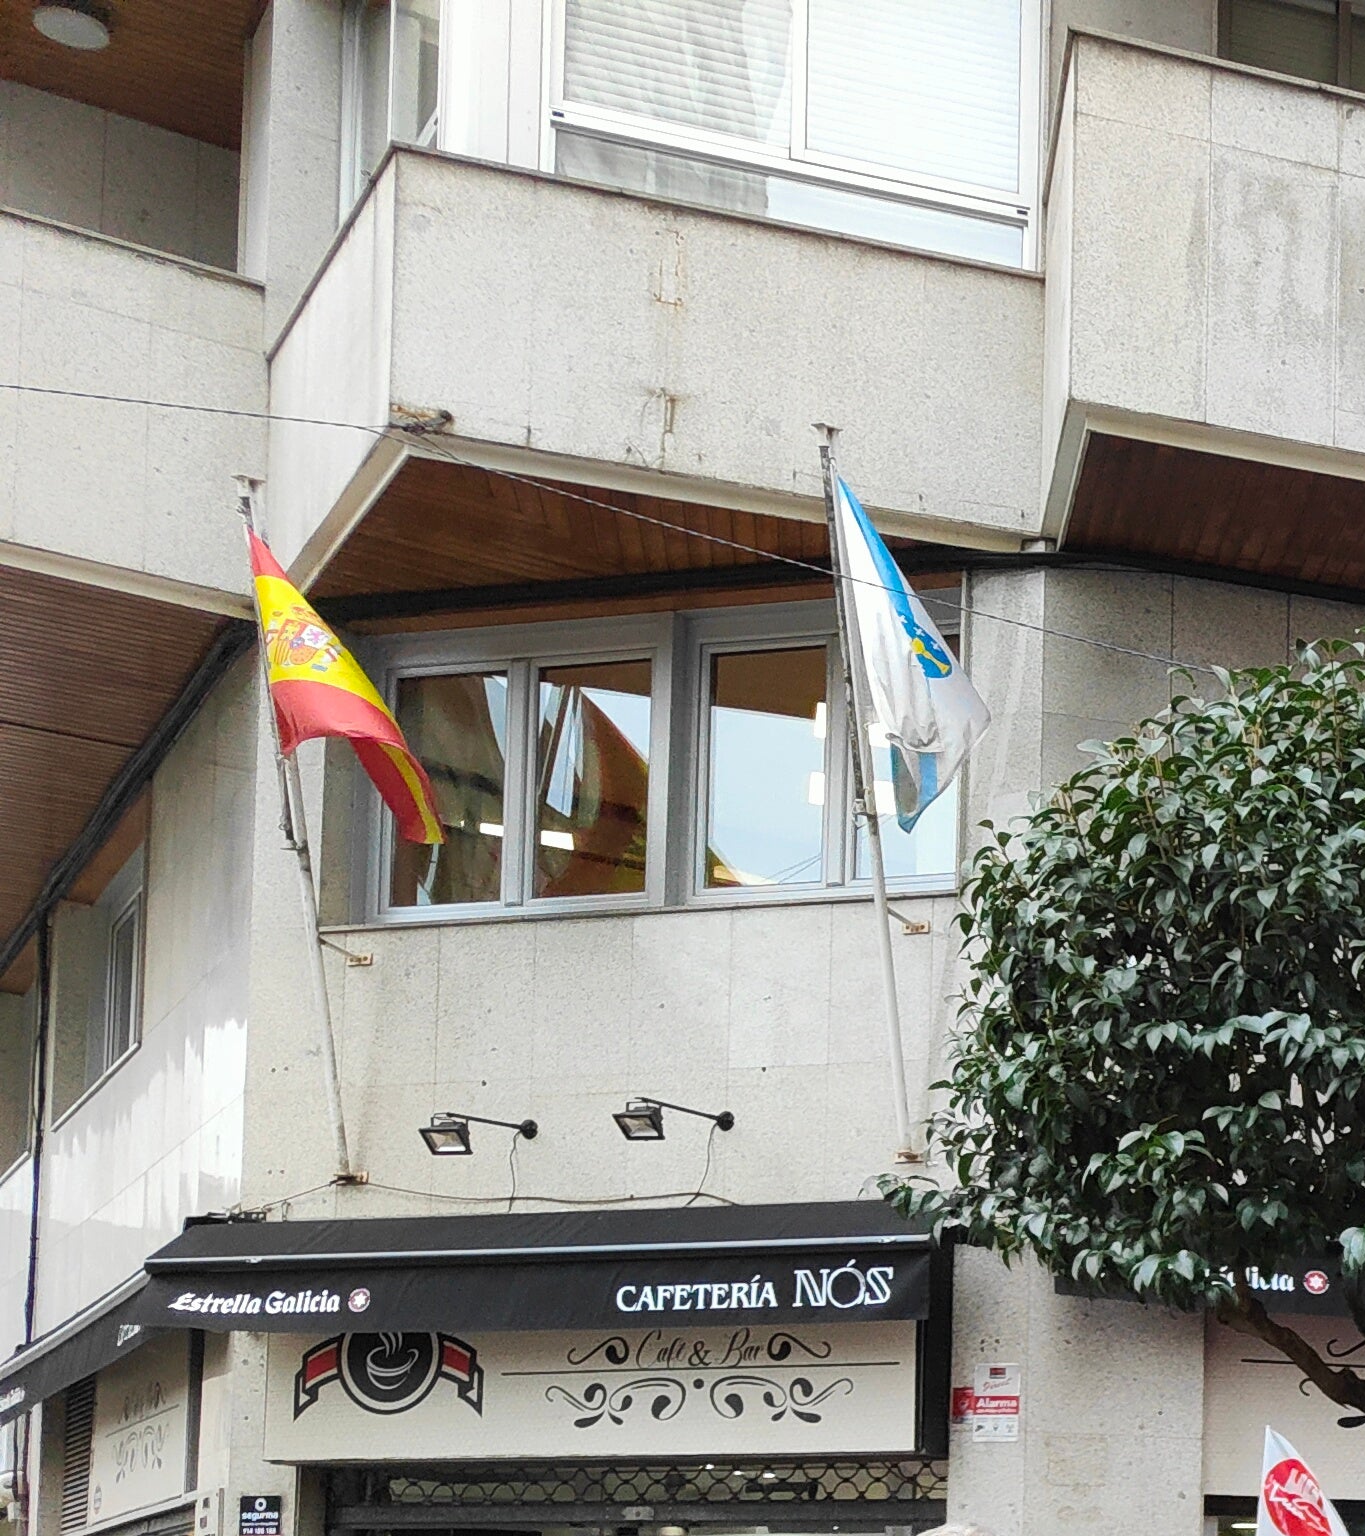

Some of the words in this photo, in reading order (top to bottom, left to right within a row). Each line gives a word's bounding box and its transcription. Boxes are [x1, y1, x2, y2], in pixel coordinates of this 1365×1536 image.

[168, 1290, 261, 1314] Estrella
[265, 1290, 339, 1314] Galicia
[616, 1275, 778, 1312] CAFETERÍA
[793, 1259, 894, 1308] NÓS
[687, 1340, 712, 1366] &
[720, 1326, 764, 1367] Bar
